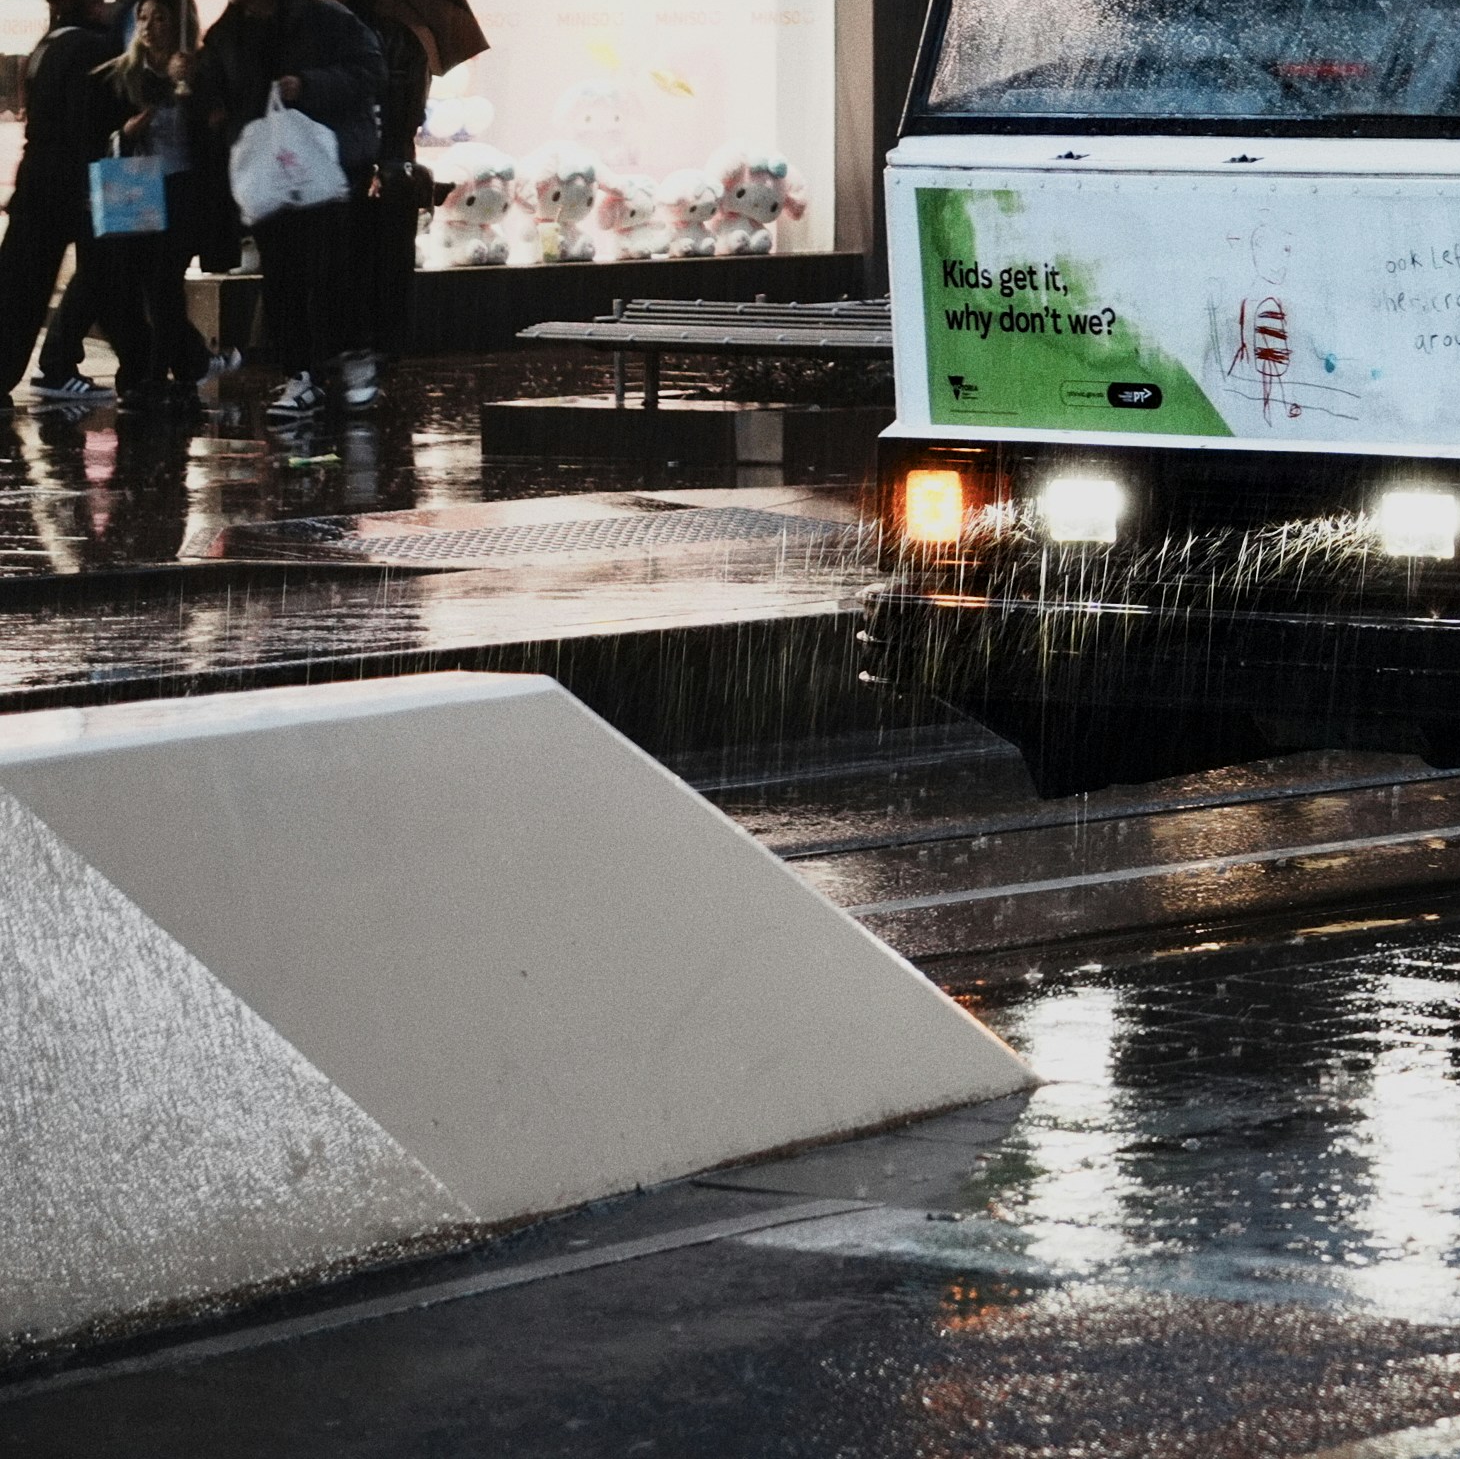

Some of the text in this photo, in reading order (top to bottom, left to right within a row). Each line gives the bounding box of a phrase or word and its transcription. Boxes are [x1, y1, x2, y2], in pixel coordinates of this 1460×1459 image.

[943, 260, 1069, 297] Kids get it,
[1385, 247, 1423, 274] ook
[944, 303, 1116, 340] why don't we?
